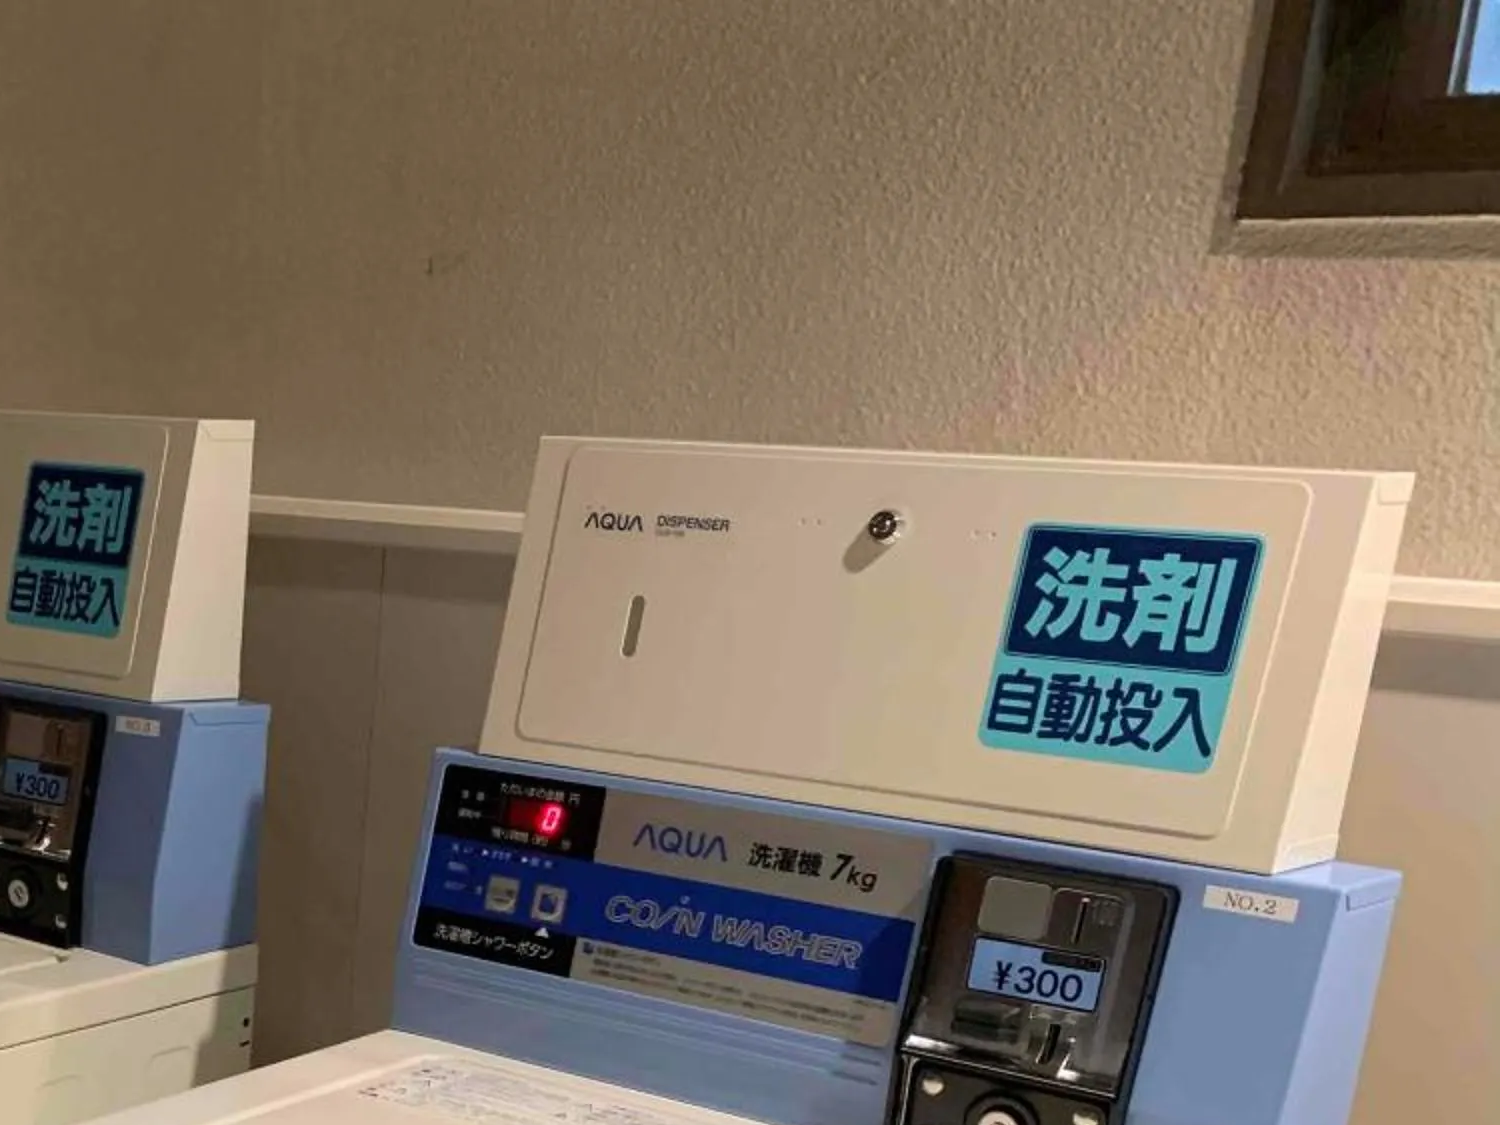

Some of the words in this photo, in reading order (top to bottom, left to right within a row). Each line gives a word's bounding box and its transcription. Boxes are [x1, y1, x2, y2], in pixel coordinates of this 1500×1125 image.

[28, 479, 133, 554] 洗剤
[584, 511, 644, 533] AQUA
[656, 514, 731, 533] DISPENSER
[8, 566, 121, 628] 自動投入
[1023, 546, 1238, 654] 洗剤
[986, 668, 1212, 758] 自動投入
[15, 771, 61, 800] ¥300
[540, 803, 563, 833] 0
[632, 823, 728, 863] AQUA
[748, 842, 824, 878] 洗濯機
[830, 853, 878, 893] 7kg
[1223, 892, 1277, 916] NO.2
[711, 914, 864, 971] WASHER
[991, 959, 1084, 1003] ¥300
